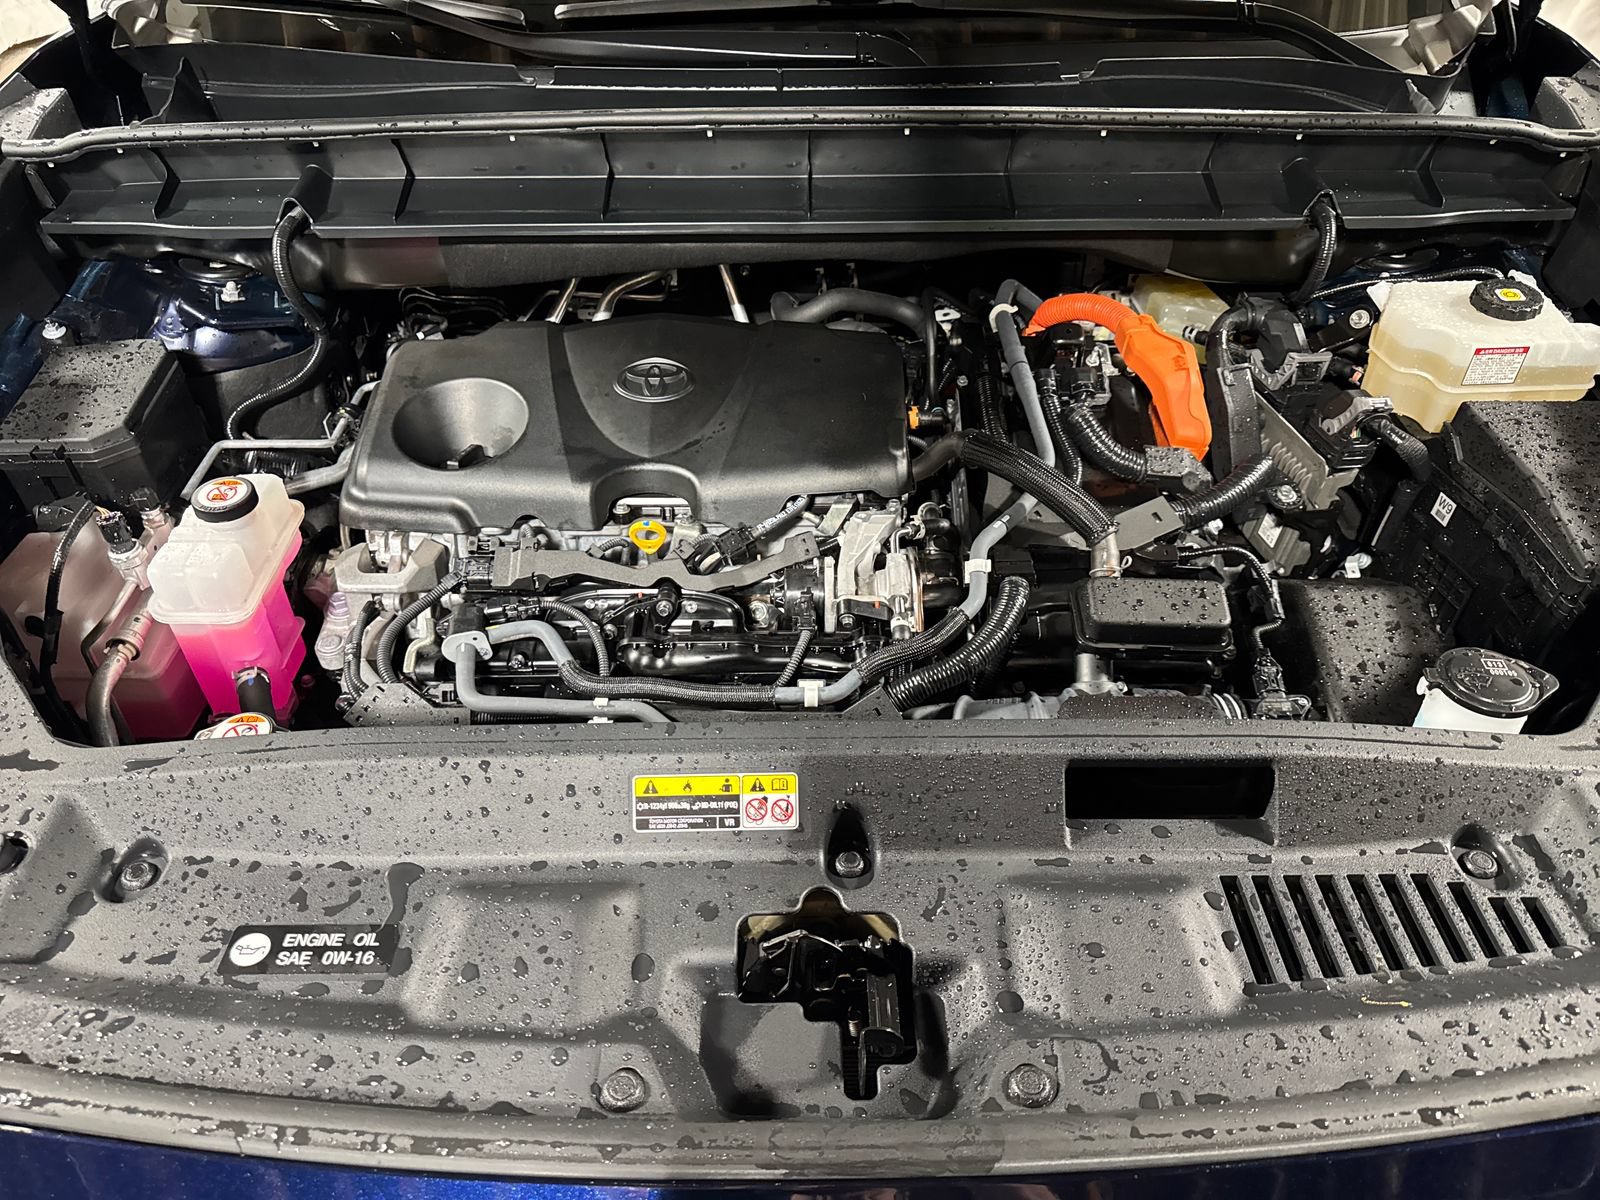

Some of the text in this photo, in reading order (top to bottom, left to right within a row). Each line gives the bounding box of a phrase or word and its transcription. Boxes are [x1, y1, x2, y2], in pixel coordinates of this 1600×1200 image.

[1438, 496, 1454, 515] W9
[725, 818, 736, 826] VR
[282, 932, 380, 947] ENGINE OIL
[275, 951, 375, 965] SAE 0W-16
